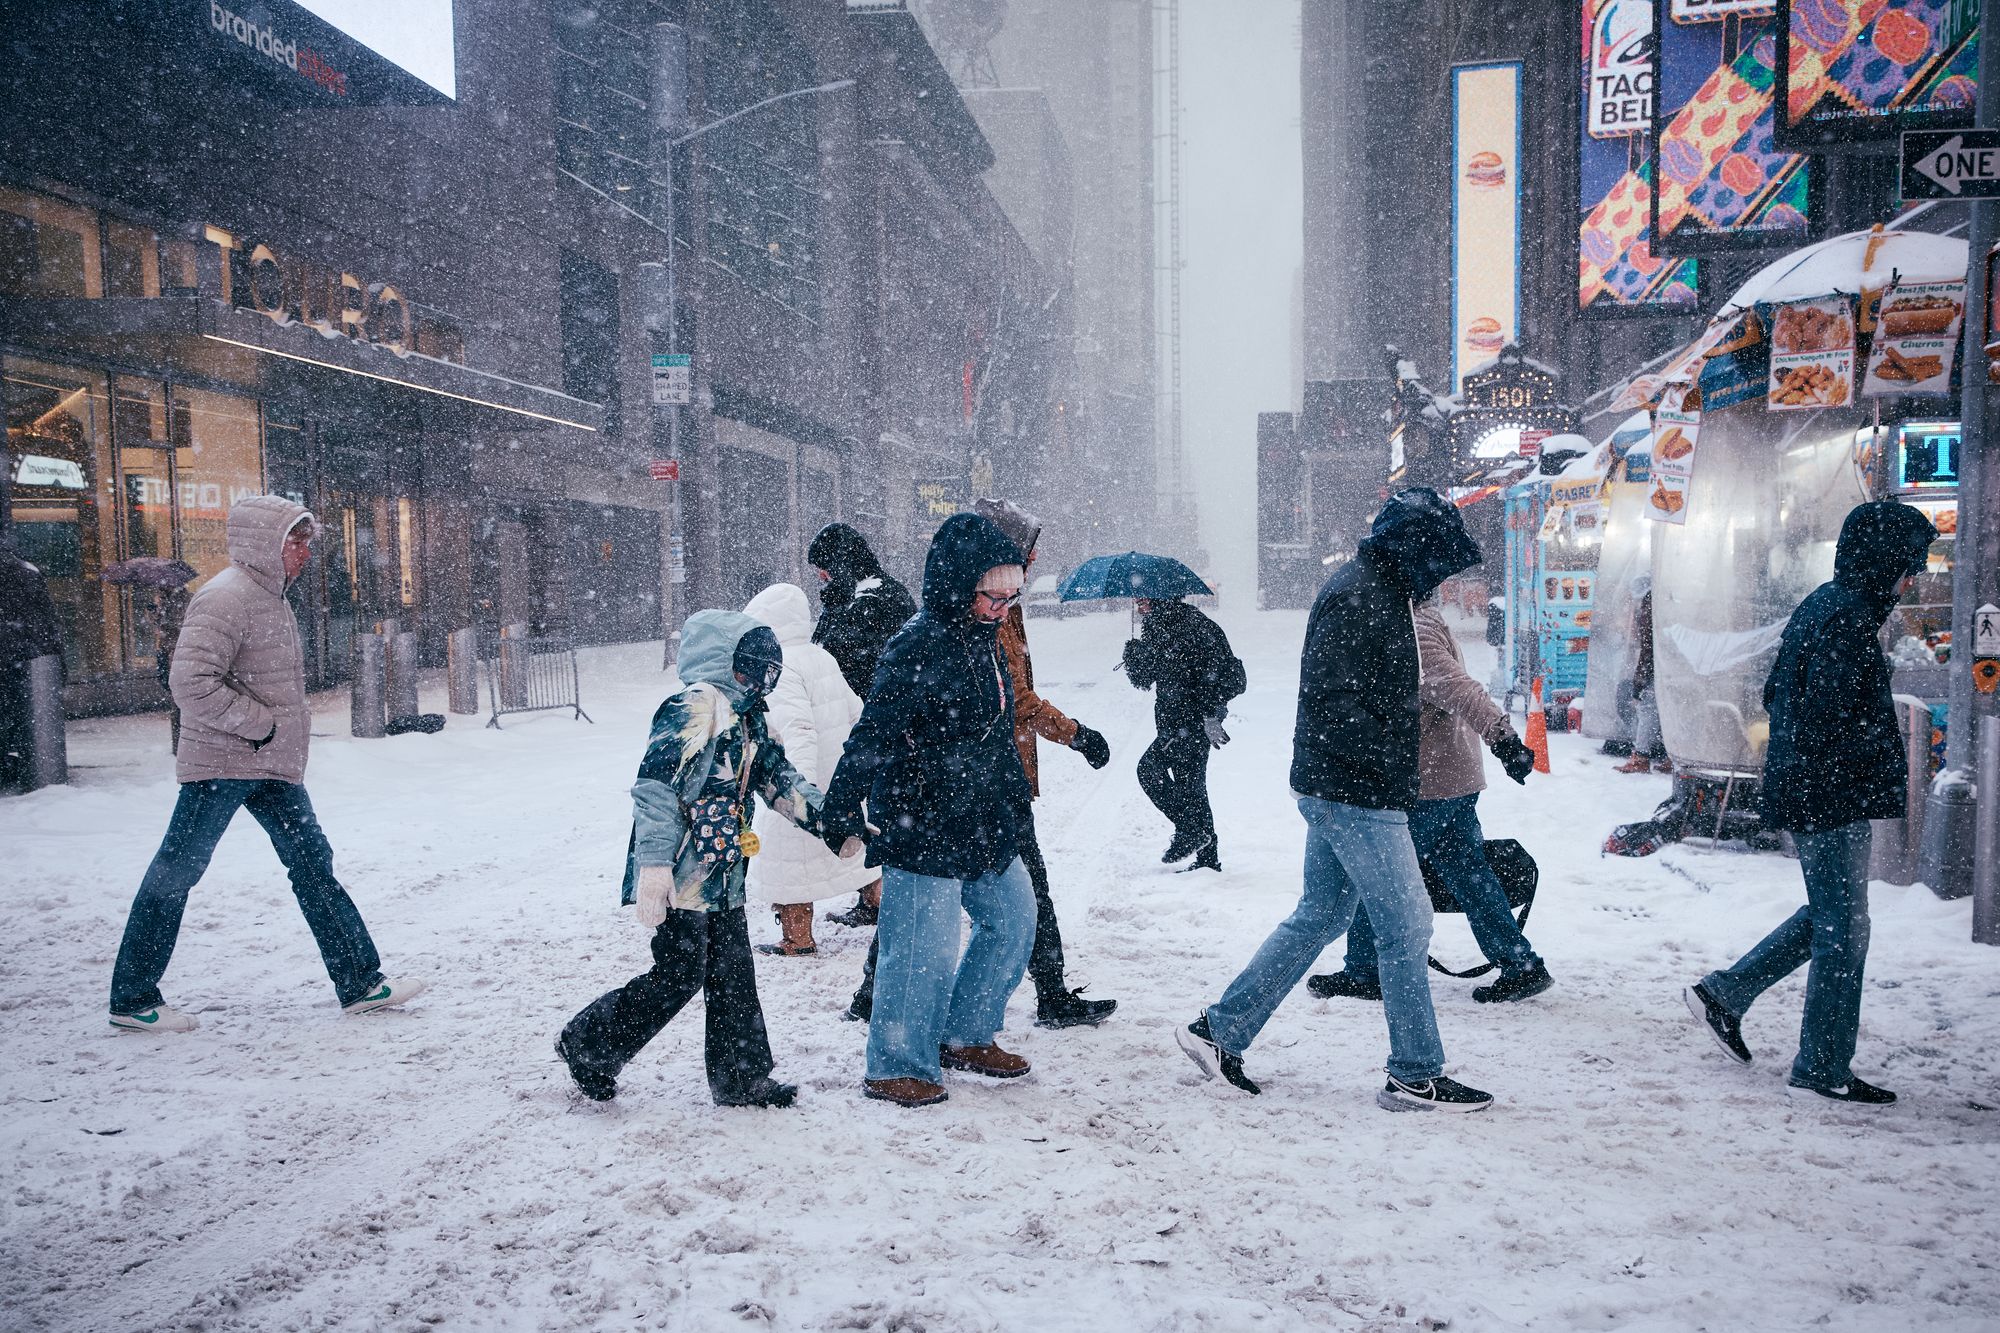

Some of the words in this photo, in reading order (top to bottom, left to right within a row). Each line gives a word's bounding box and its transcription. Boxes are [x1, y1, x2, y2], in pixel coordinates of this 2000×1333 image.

[1935, 151, 1995, 178] ONE
[1946, 284, 1963, 292] Dog
[1901, 340, 1944, 349] Churros
[1775, 356, 1799, 364] Chicken
[655, 382, 688, 391] SHARED
[660, 392, 682, 401] LANE
[1491, 387, 1532, 407] 1501
[1555, 484, 1597, 501] SABRET
